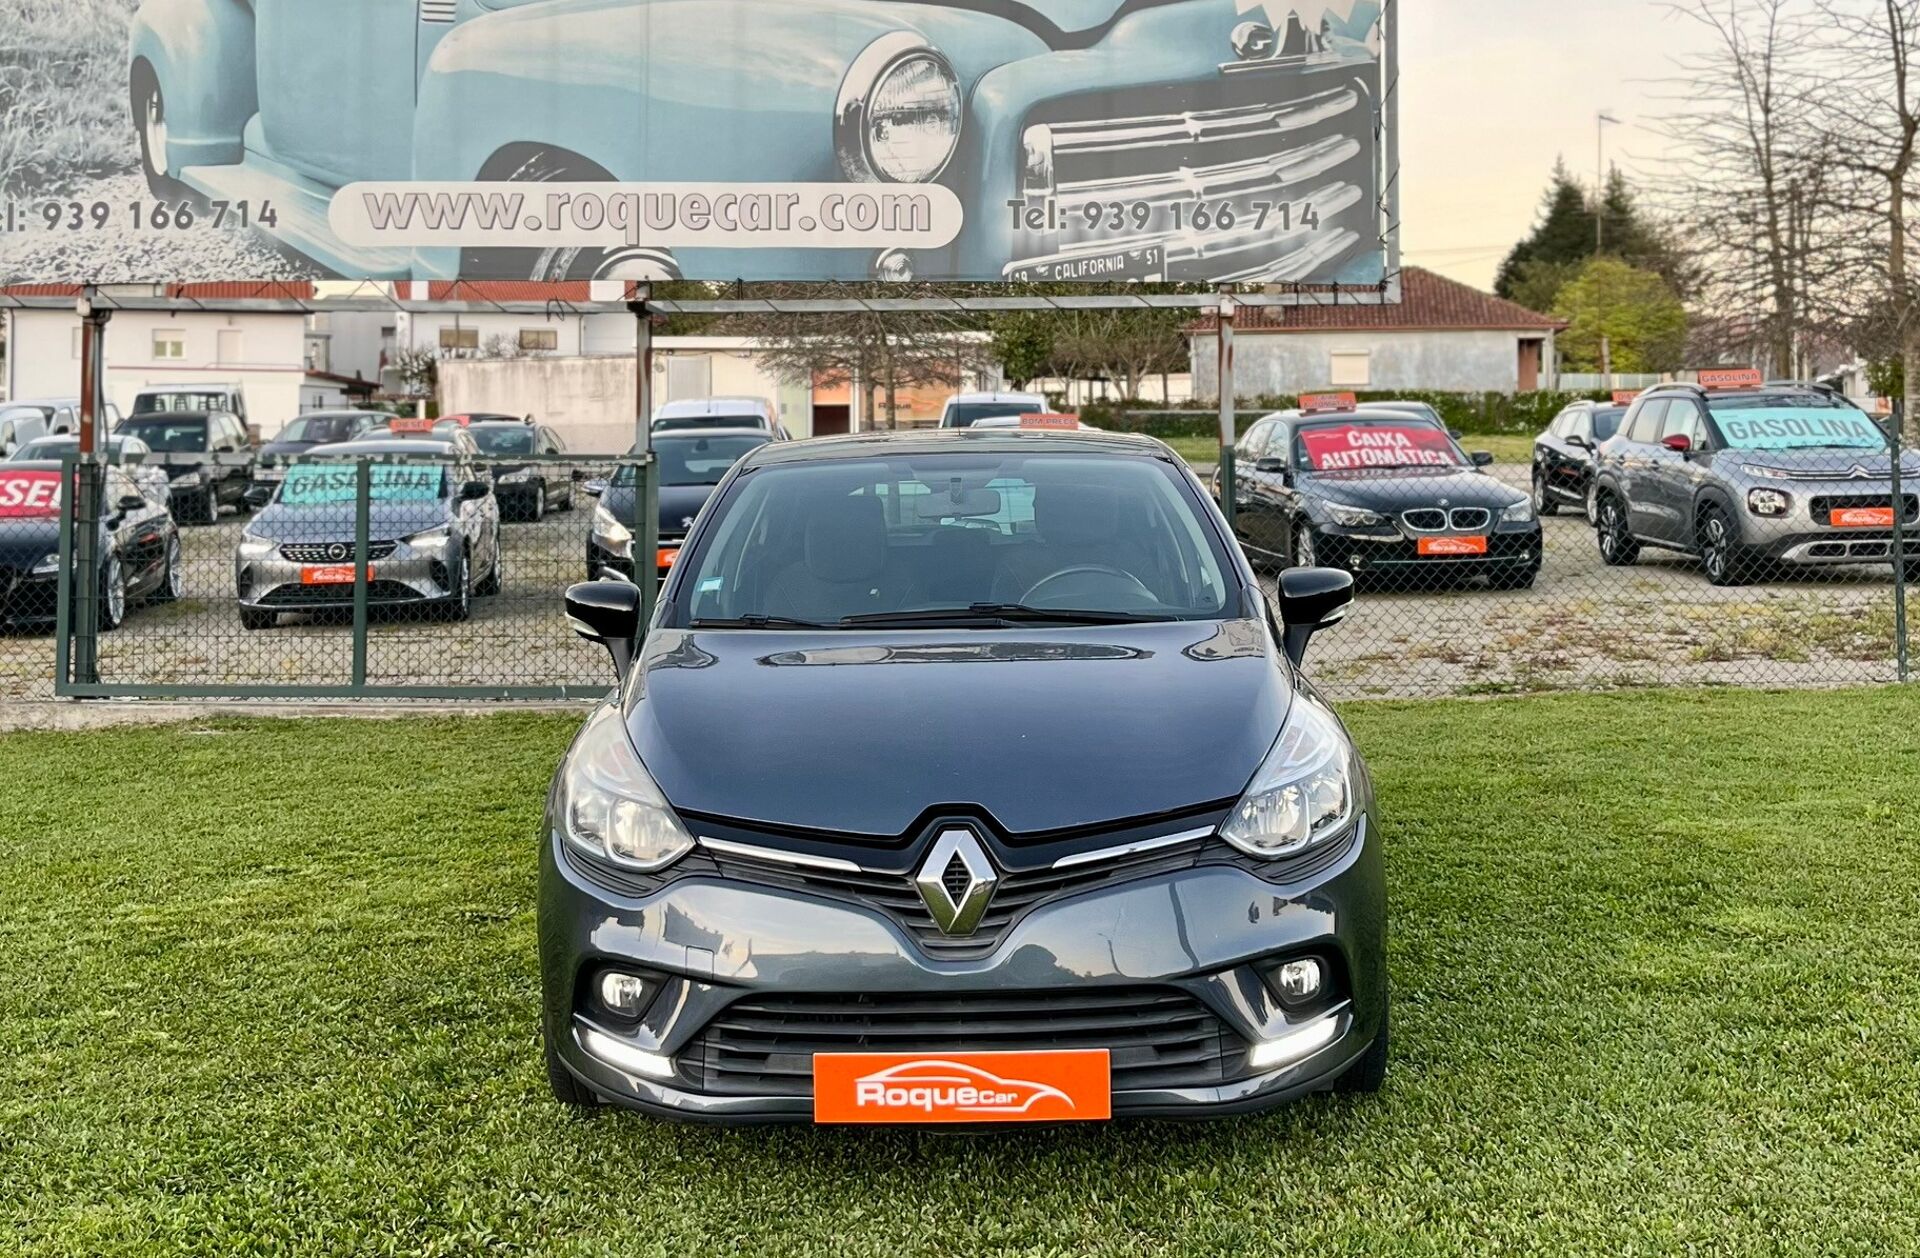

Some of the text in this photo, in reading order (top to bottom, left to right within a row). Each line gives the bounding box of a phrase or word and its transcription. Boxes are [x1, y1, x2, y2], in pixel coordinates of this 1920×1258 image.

[0, 200, 278, 232] l: 939 166 714
[363, 193, 931, 246] www.roquecar.com
[1007, 200, 1319, 231] Tel: 939 166 714
[1054, 255, 1124, 280] CALIFORNIA
[1146, 249, 1158, 265] 51
[1701, 372, 1757, 382] GASOLINA
[1347, 430, 1412, 447] CAIXA
[1726, 418, 1873, 440] GASOLINA
[1321, 446, 1454, 469] AUTOMÁTICA
